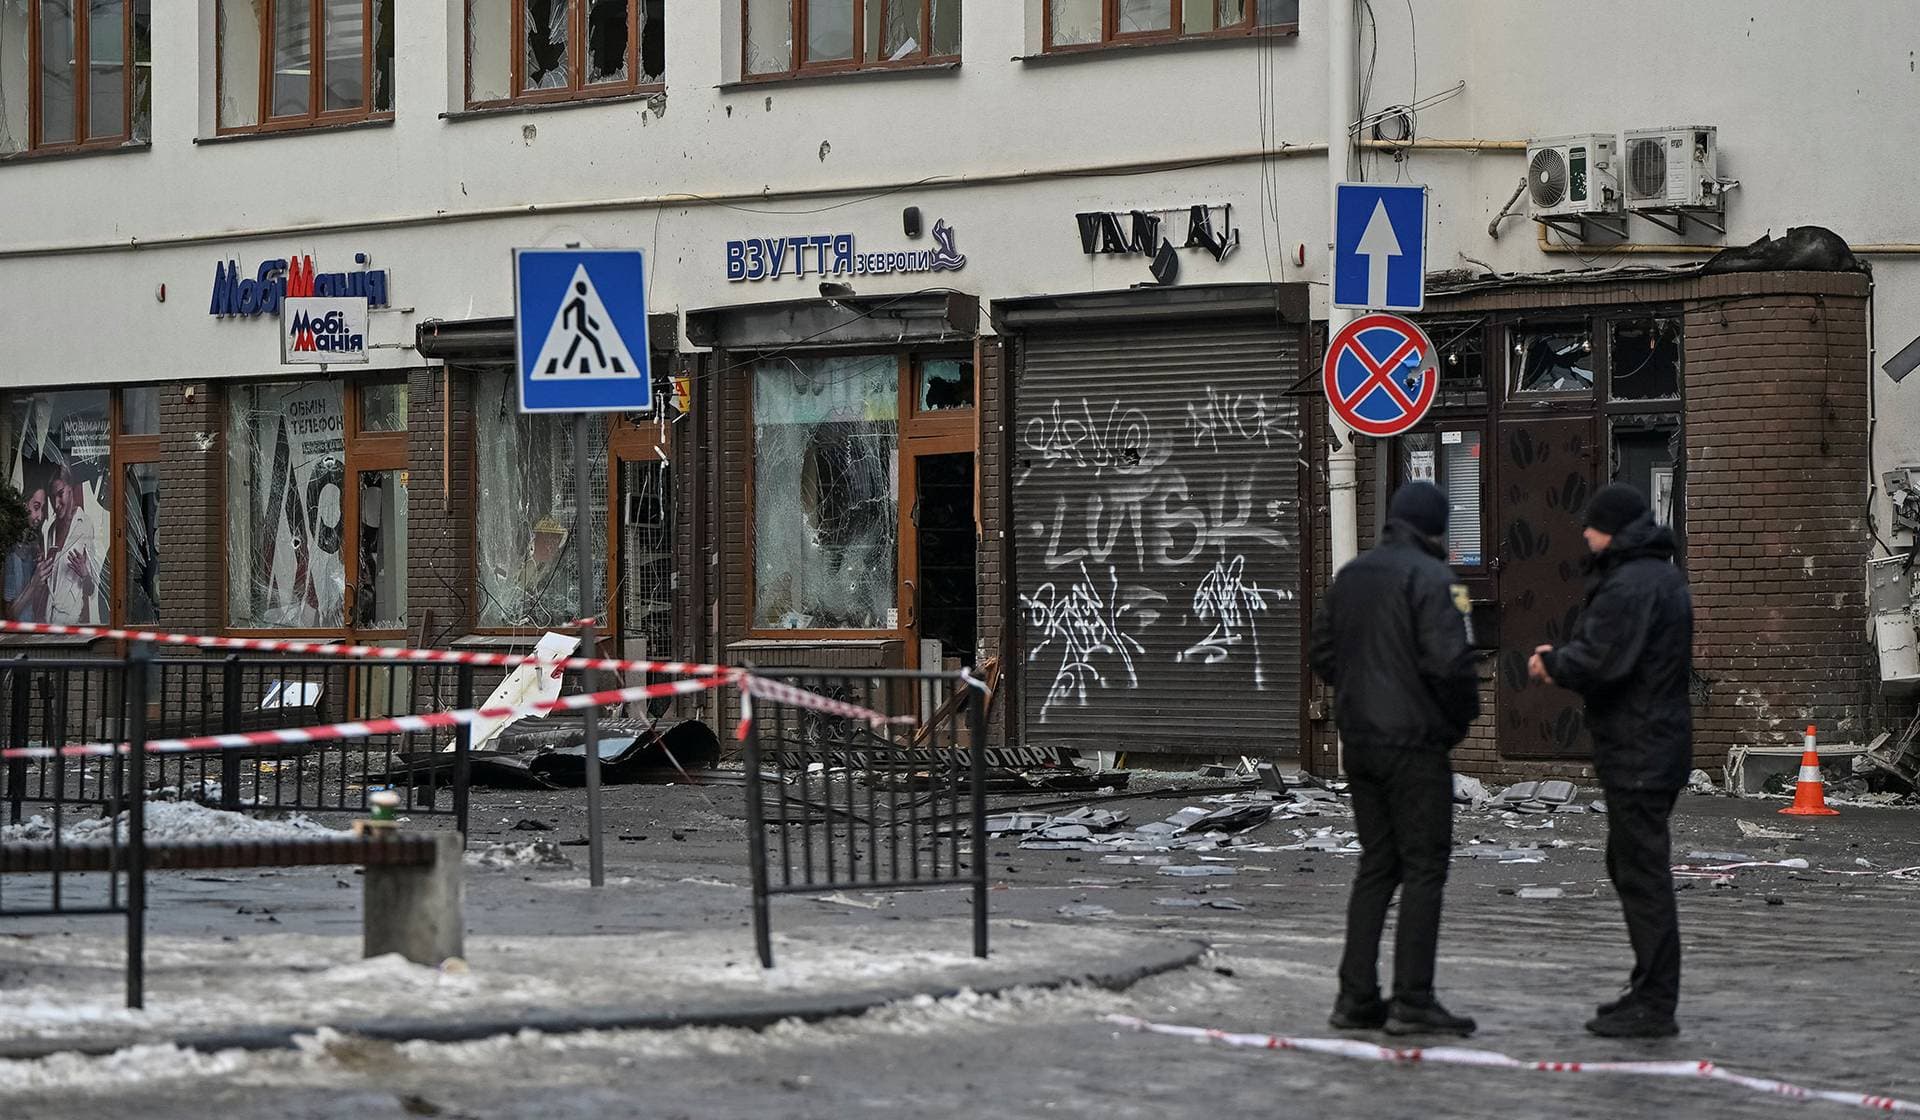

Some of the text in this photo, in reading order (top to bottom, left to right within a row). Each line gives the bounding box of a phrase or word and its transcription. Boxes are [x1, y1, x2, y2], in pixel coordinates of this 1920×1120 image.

[726, 232, 856, 281] ВЗУТТЯ
[290, 309, 344, 334] Мобі
[290, 399, 326, 416] ОБМІН
[1000, 746, 1061, 766] ПАРУ
